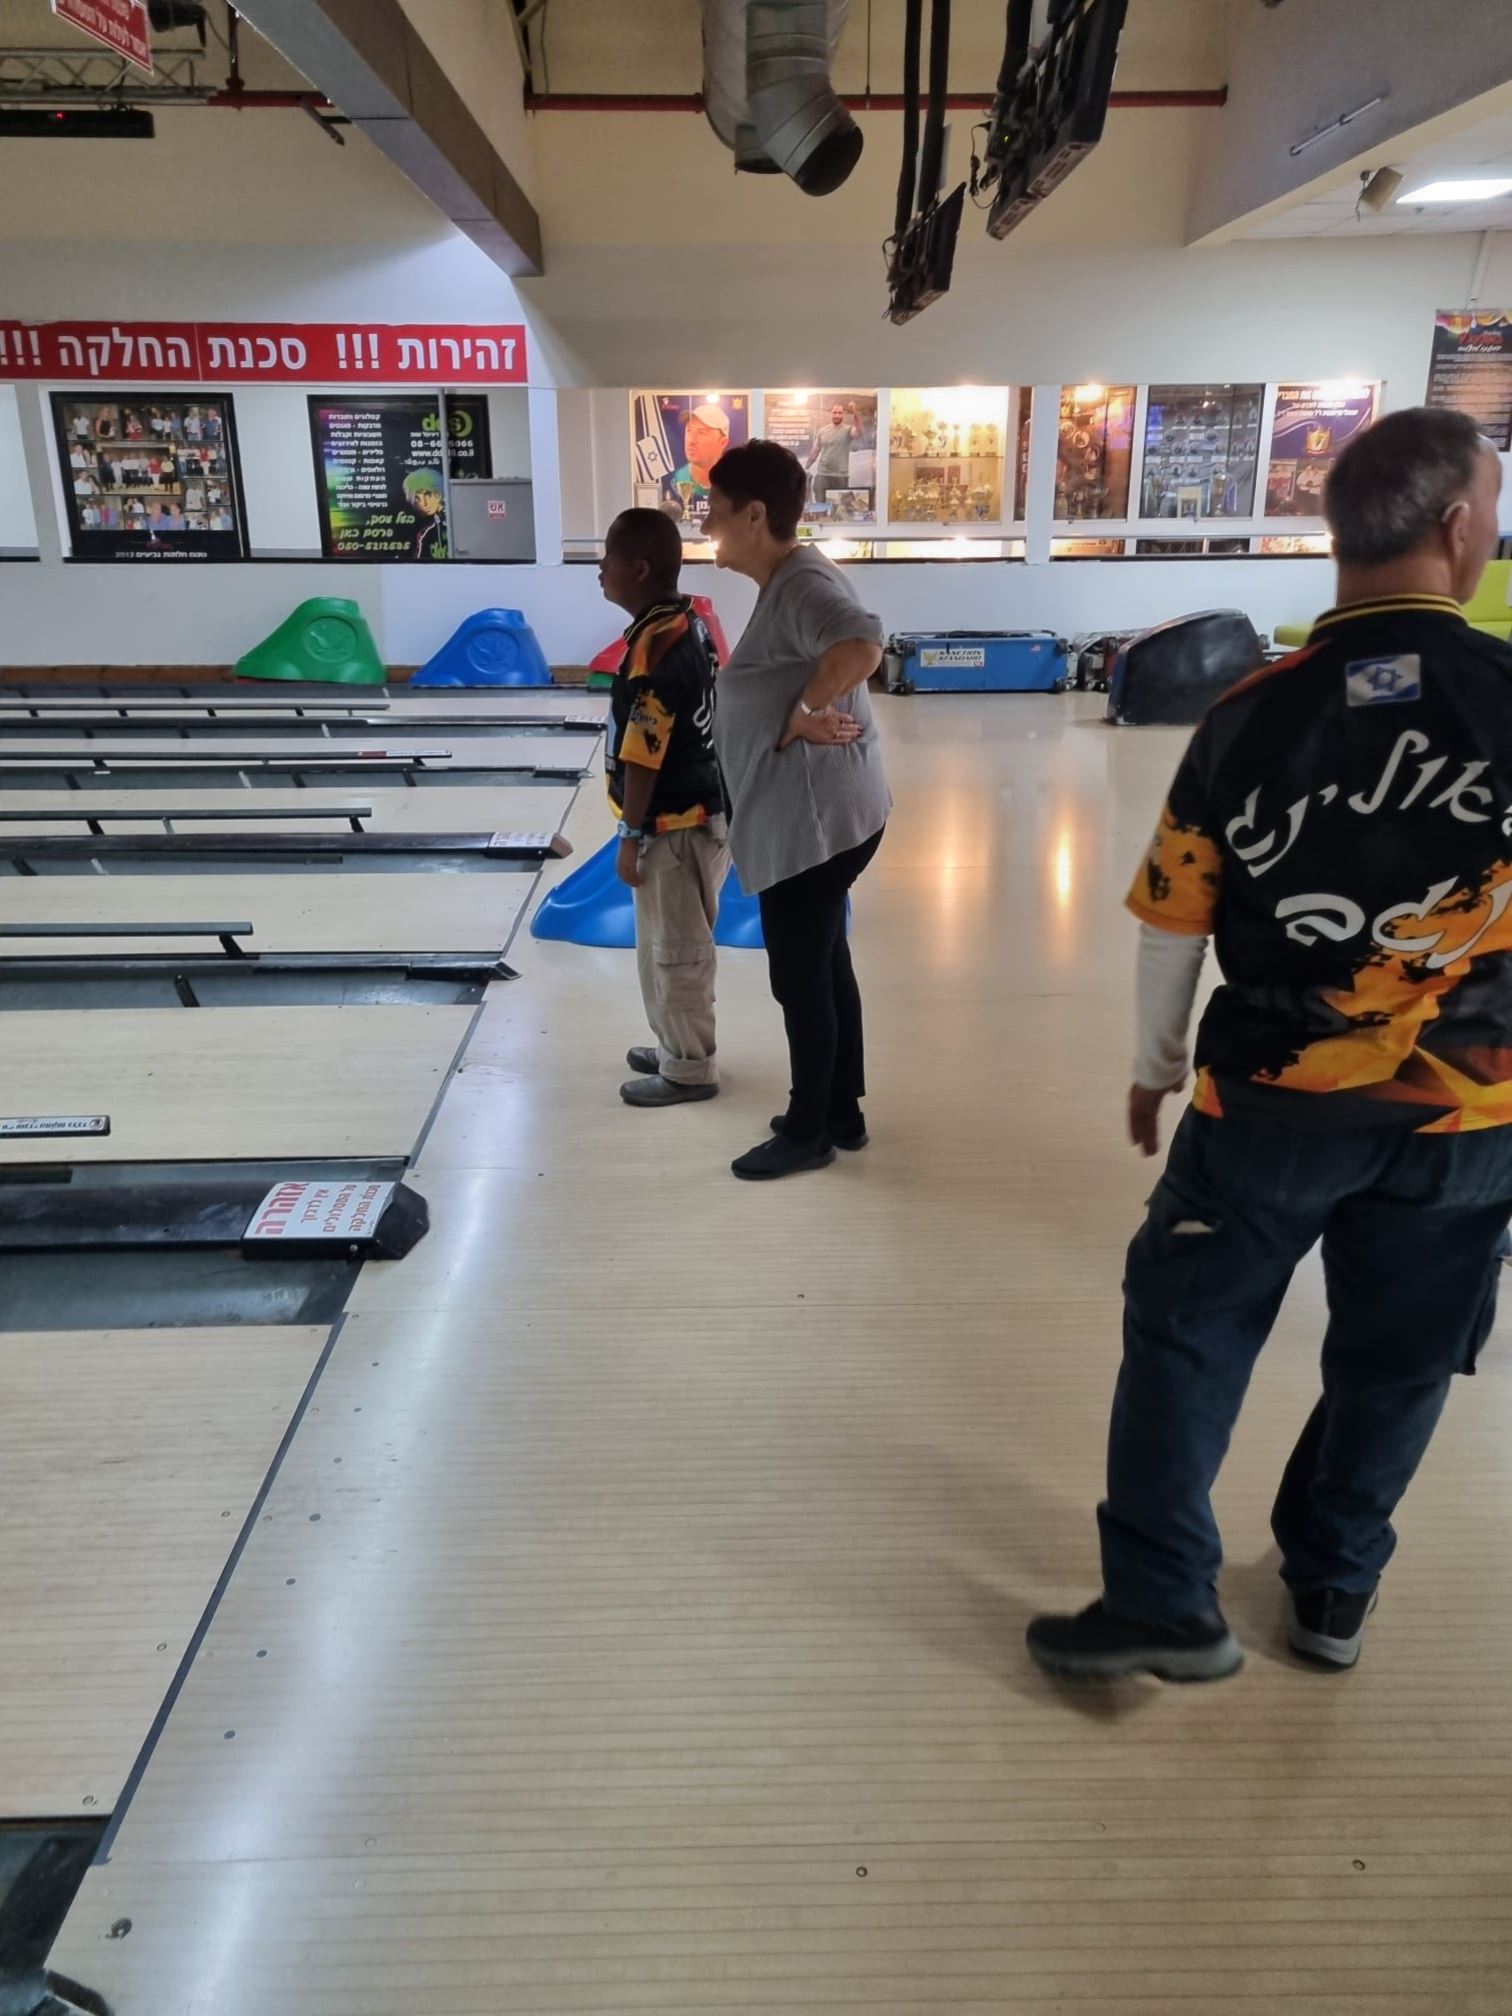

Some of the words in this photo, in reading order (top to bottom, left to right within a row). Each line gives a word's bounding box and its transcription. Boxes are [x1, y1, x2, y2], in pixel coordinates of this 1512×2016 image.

[59, 328, 190, 376] החלקה
[209, 336, 307, 369] סכנת
[336, 333, 380, 369] !!!
[398, 338, 516, 370] זהירות
[410, 440, 474, 448] 08-665066
[1224, 729, 1512, 878] אולינג
[254, 1182, 311, 1235] אזהרה
